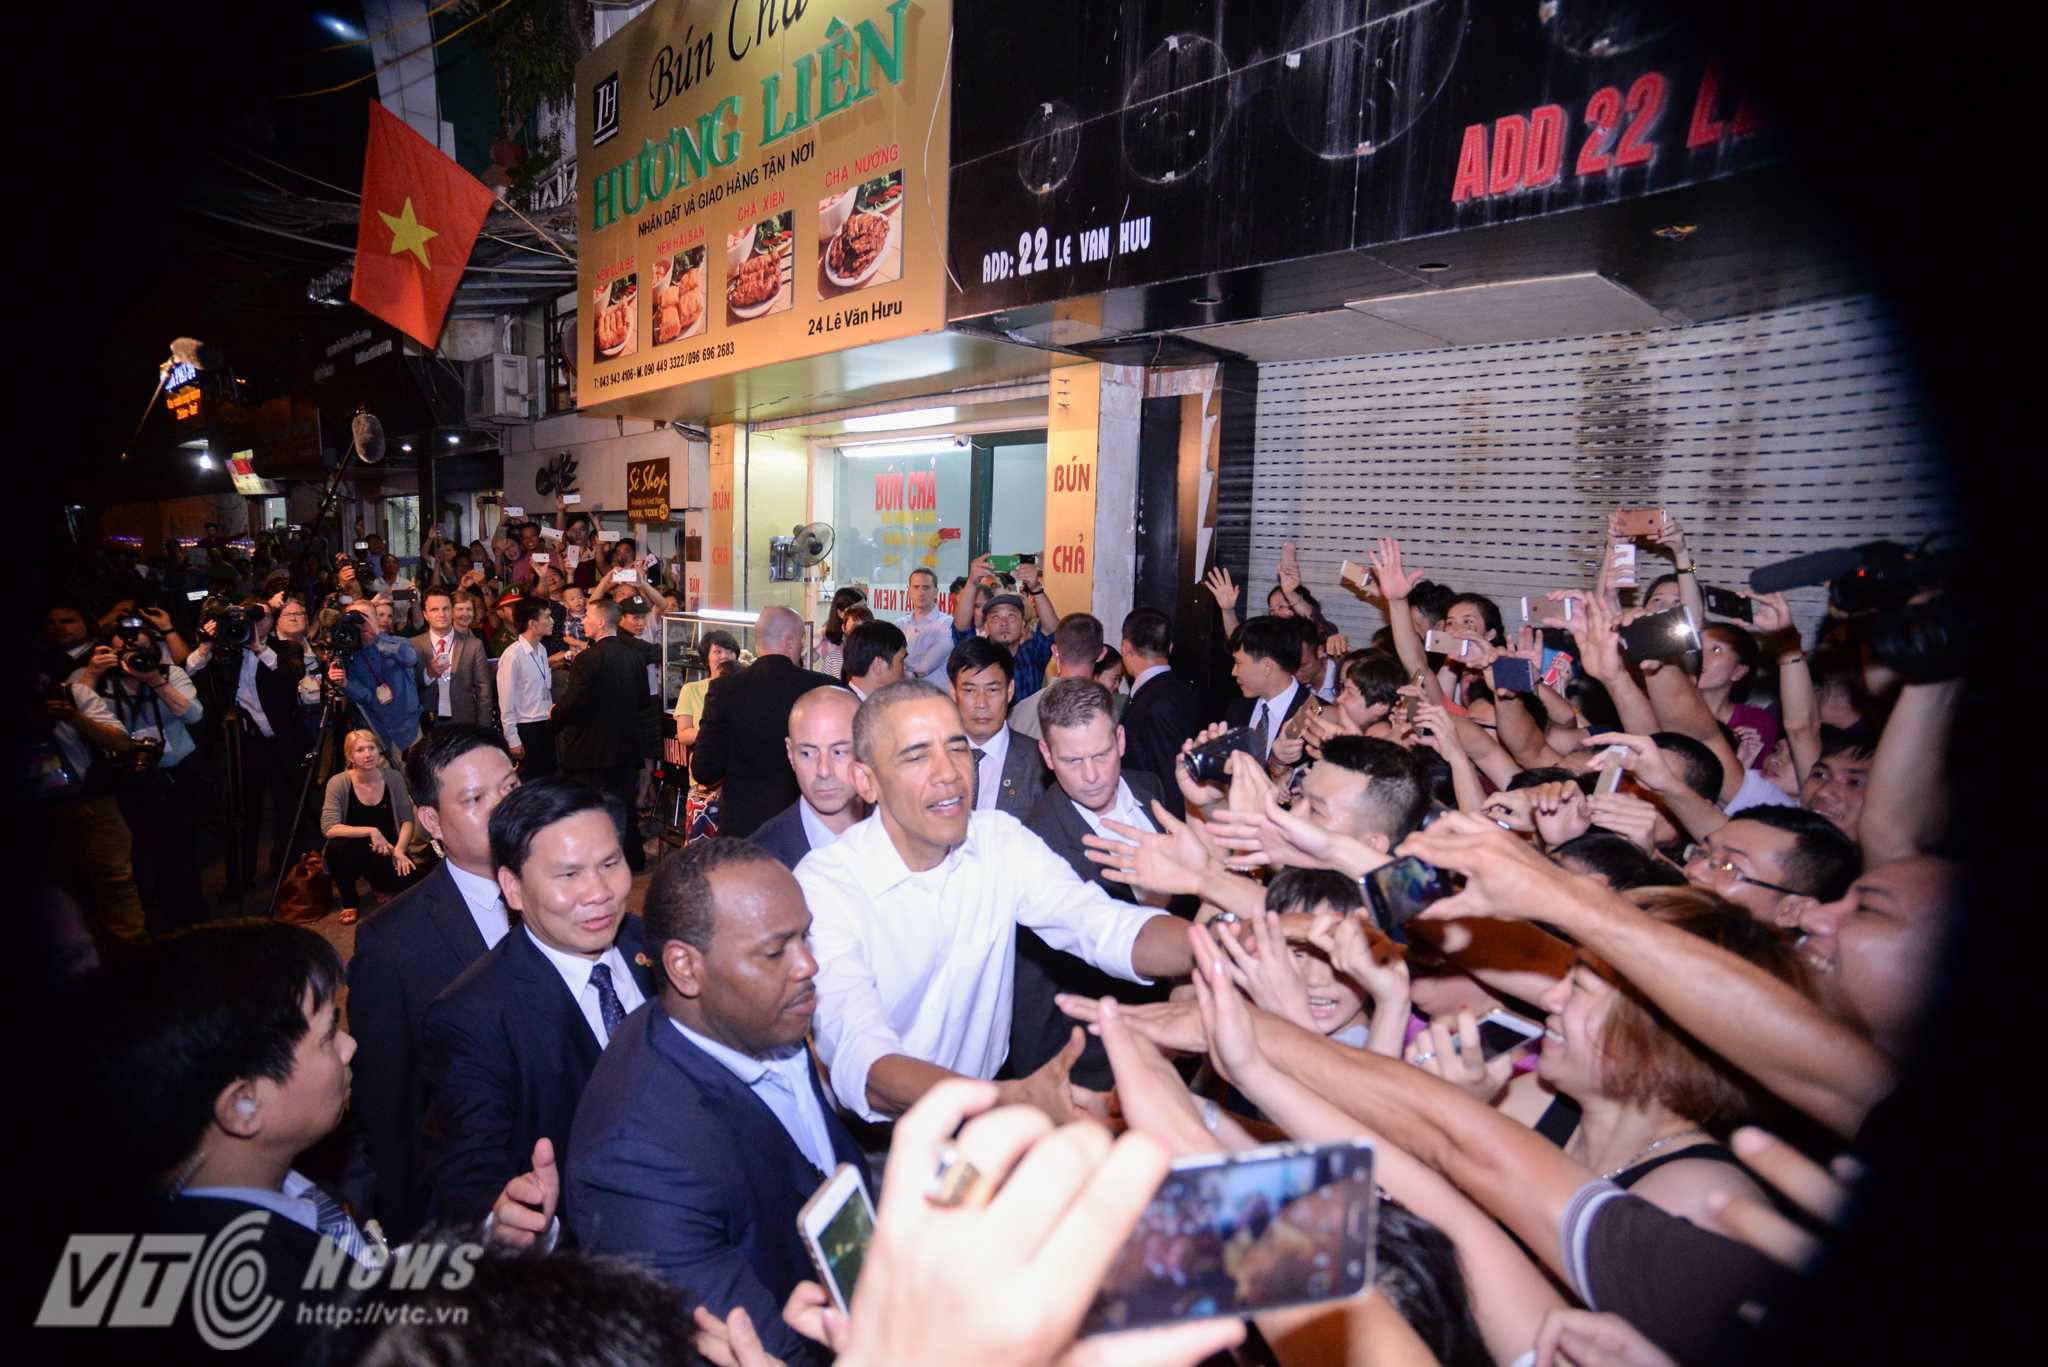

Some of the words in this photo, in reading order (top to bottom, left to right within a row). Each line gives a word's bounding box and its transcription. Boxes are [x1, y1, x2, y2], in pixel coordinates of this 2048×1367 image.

[650, 25, 715, 111] Bún
[592, 95, 742, 233] HƯƠNG
[759, 0, 910, 146] LIÊN
[1451, 104, 1567, 204] ADD
[1575, 72, 1667, 177] 22
[698, 184, 723, 209] GIAO
[726, 168, 759, 197] HÀNG
[762, 155, 785, 185] TẬN
[791, 141, 814, 167] NƠI
[982, 251, 1014, 284] ADD:
[1018, 226, 1048, 276] 22
[1055, 235, 1072, 268] LE
[1079, 226, 1110, 263] VAN
[1119, 216, 1151, 255] HUU
[808, 317, 823, 335] 24
[826, 313, 841, 332] Lê
[844, 308, 868, 328] Văn
[656, 359, 668, 373] 449
[703, 346, 714, 361] 696
[718, 341, 735, 358] 2683
[641, 464, 668, 495] Shop
[1054, 456, 1090, 492] BÚN
[1053, 533, 1085, 573] CHẢ
